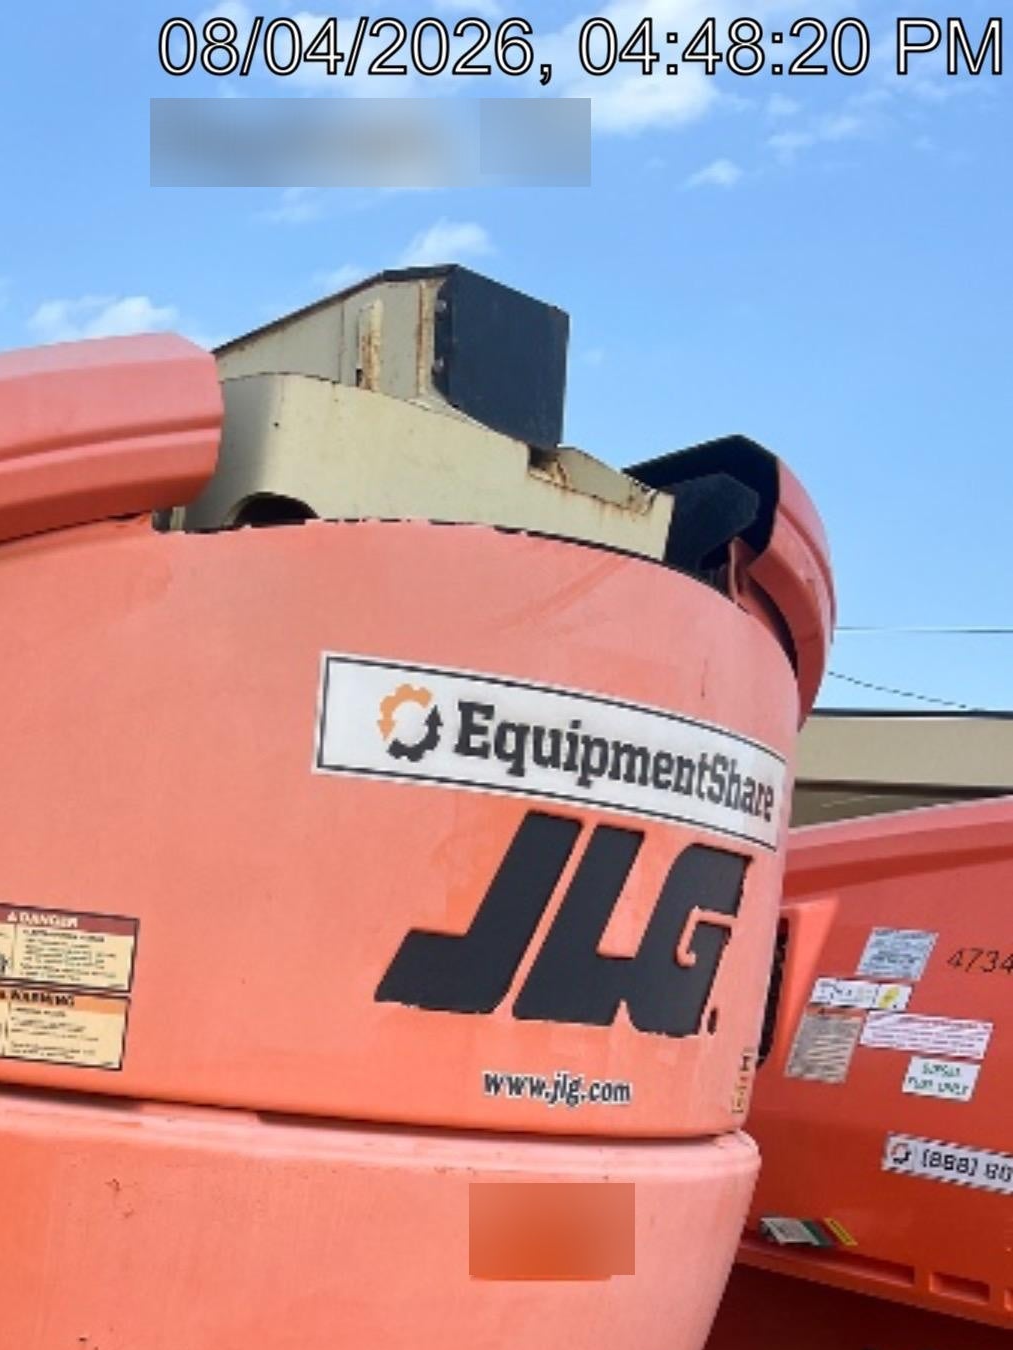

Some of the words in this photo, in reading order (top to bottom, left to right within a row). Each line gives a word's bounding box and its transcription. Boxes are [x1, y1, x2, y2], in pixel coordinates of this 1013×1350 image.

[453, 699, 775, 822] EquipmentShare
[19, 911, 79, 928] DANGER
[374, 809, 754, 1038] JLG
[10, 989, 76, 1007] WARNING
[483, 1071, 632, 1107] www.jlg.com
[921, 1148, 980, 1177] (888)
